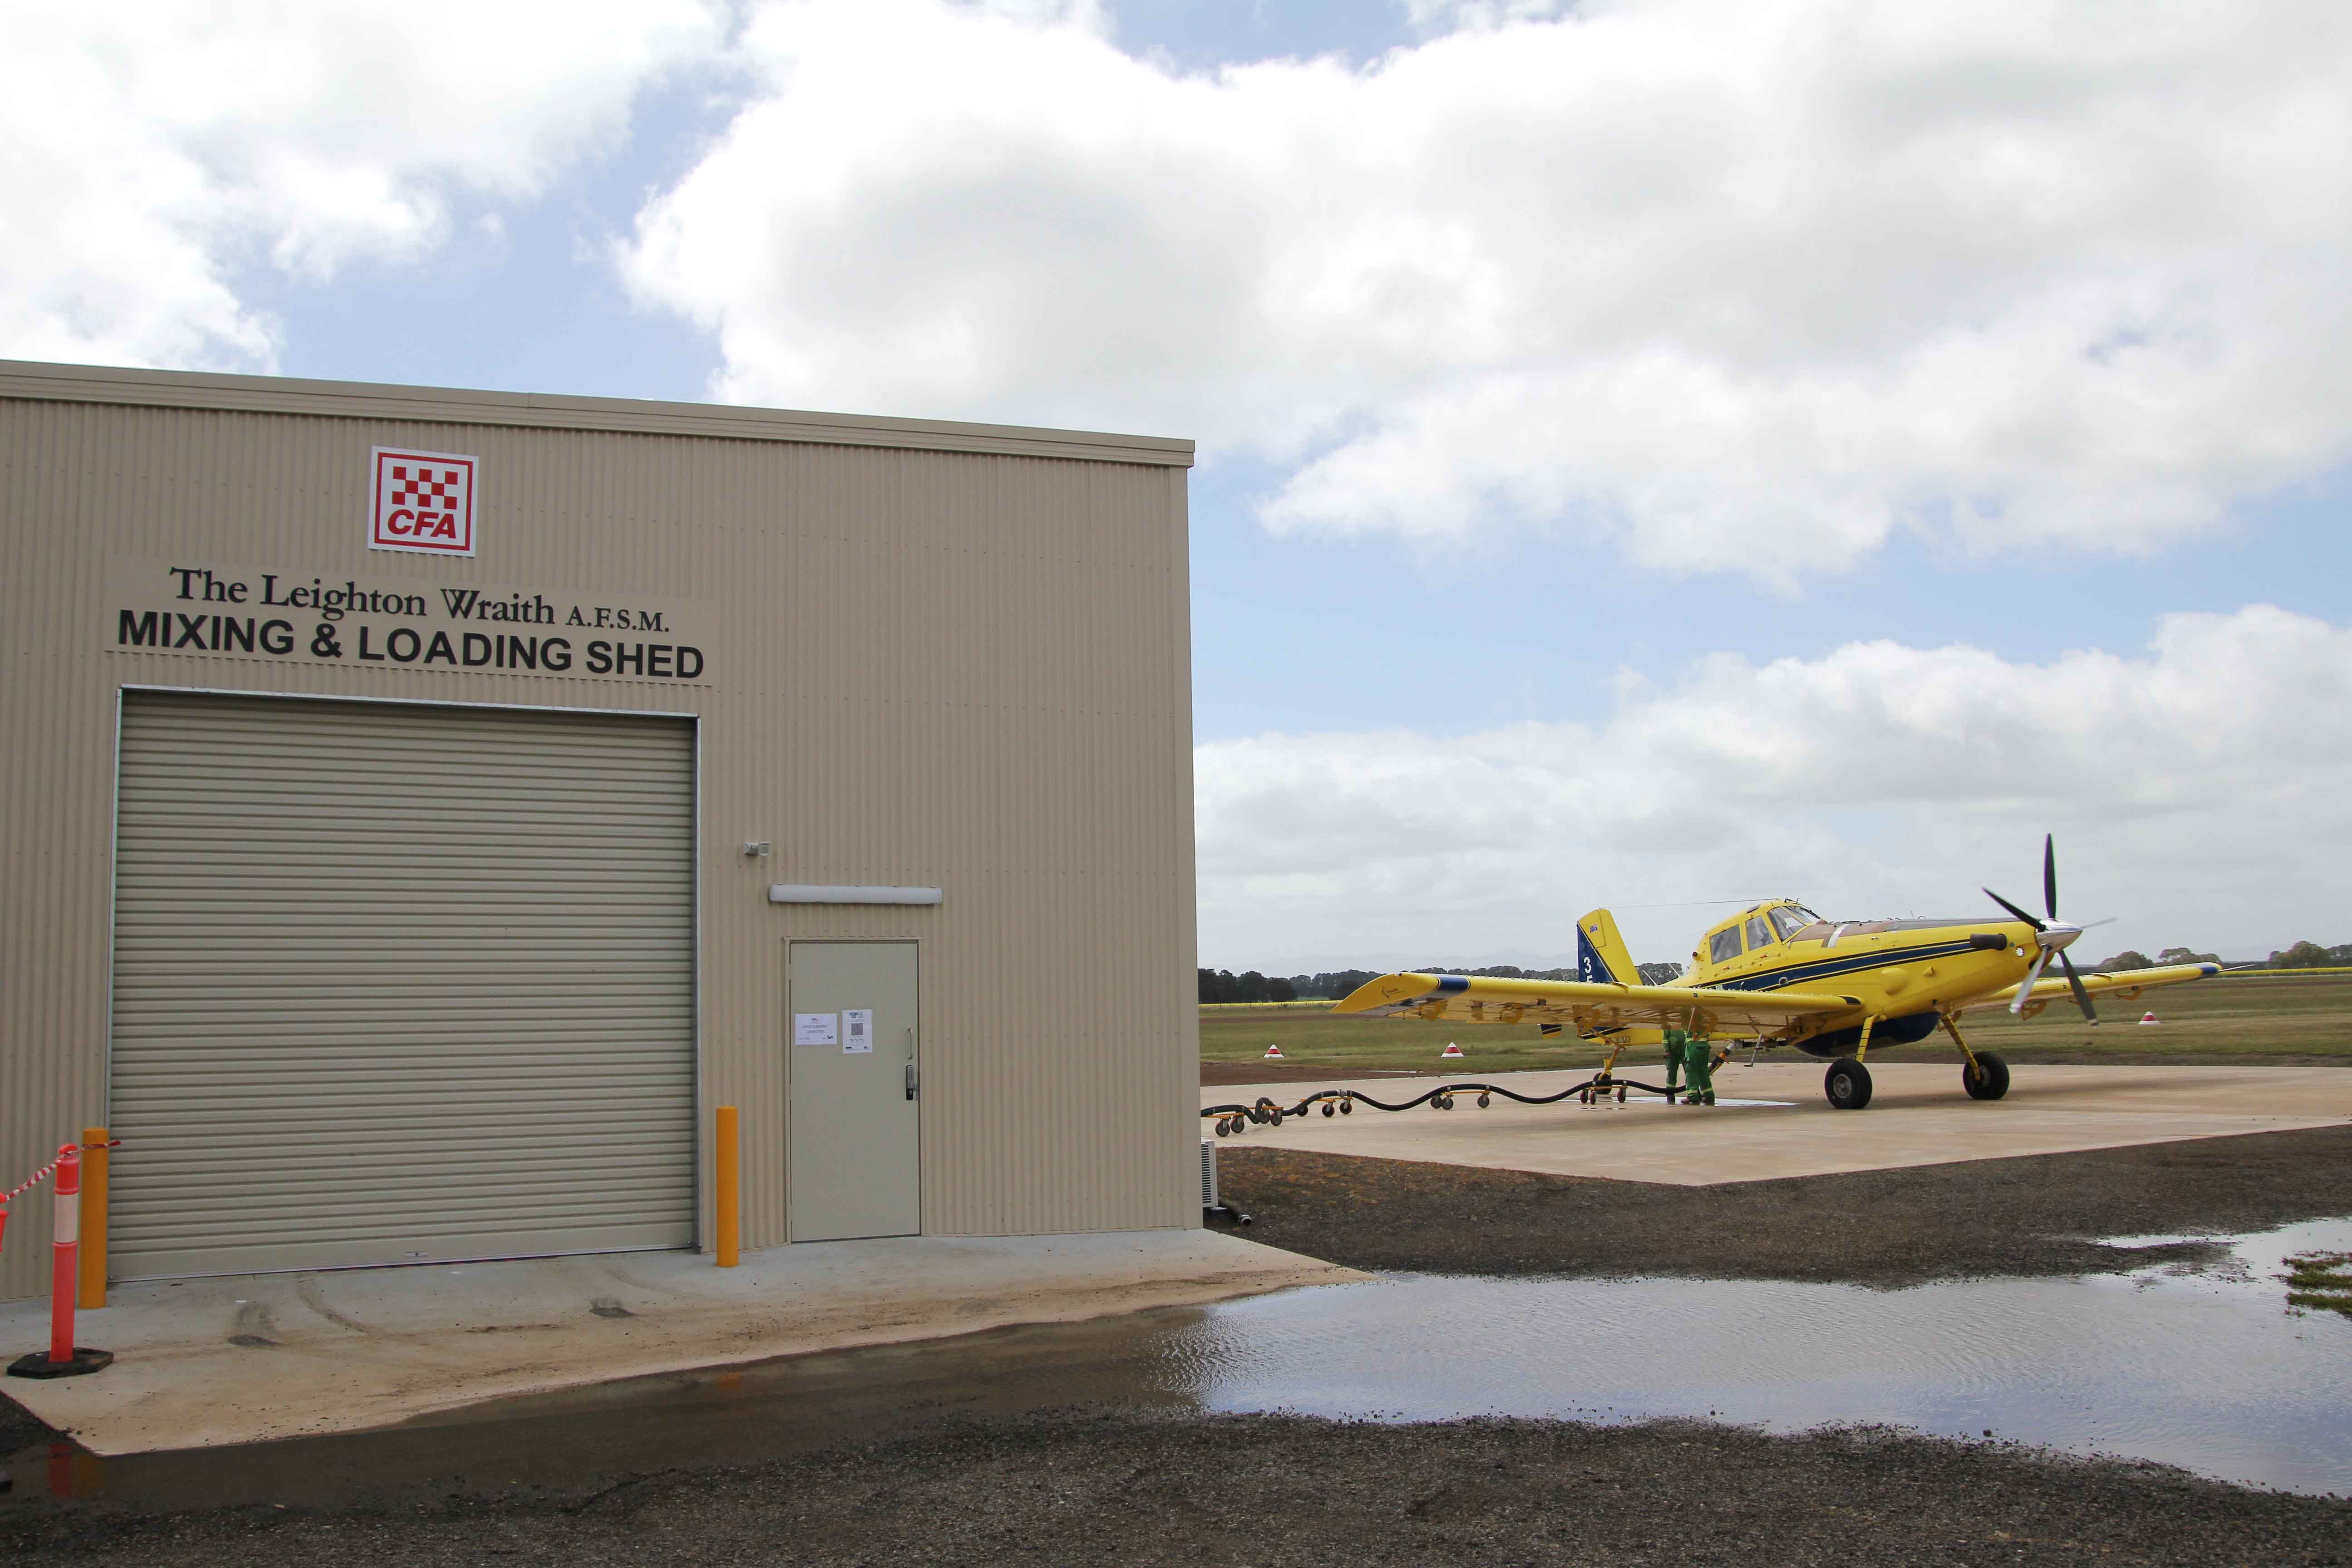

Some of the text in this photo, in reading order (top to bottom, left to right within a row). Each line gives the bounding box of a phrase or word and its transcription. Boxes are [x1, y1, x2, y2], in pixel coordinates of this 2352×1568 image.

[387, 509, 457, 539] CFA
[169, 567, 669, 632] The Leighton Wraith A.F.S.M.
[118, 609, 704, 678] MIXING & LOADING SHED
